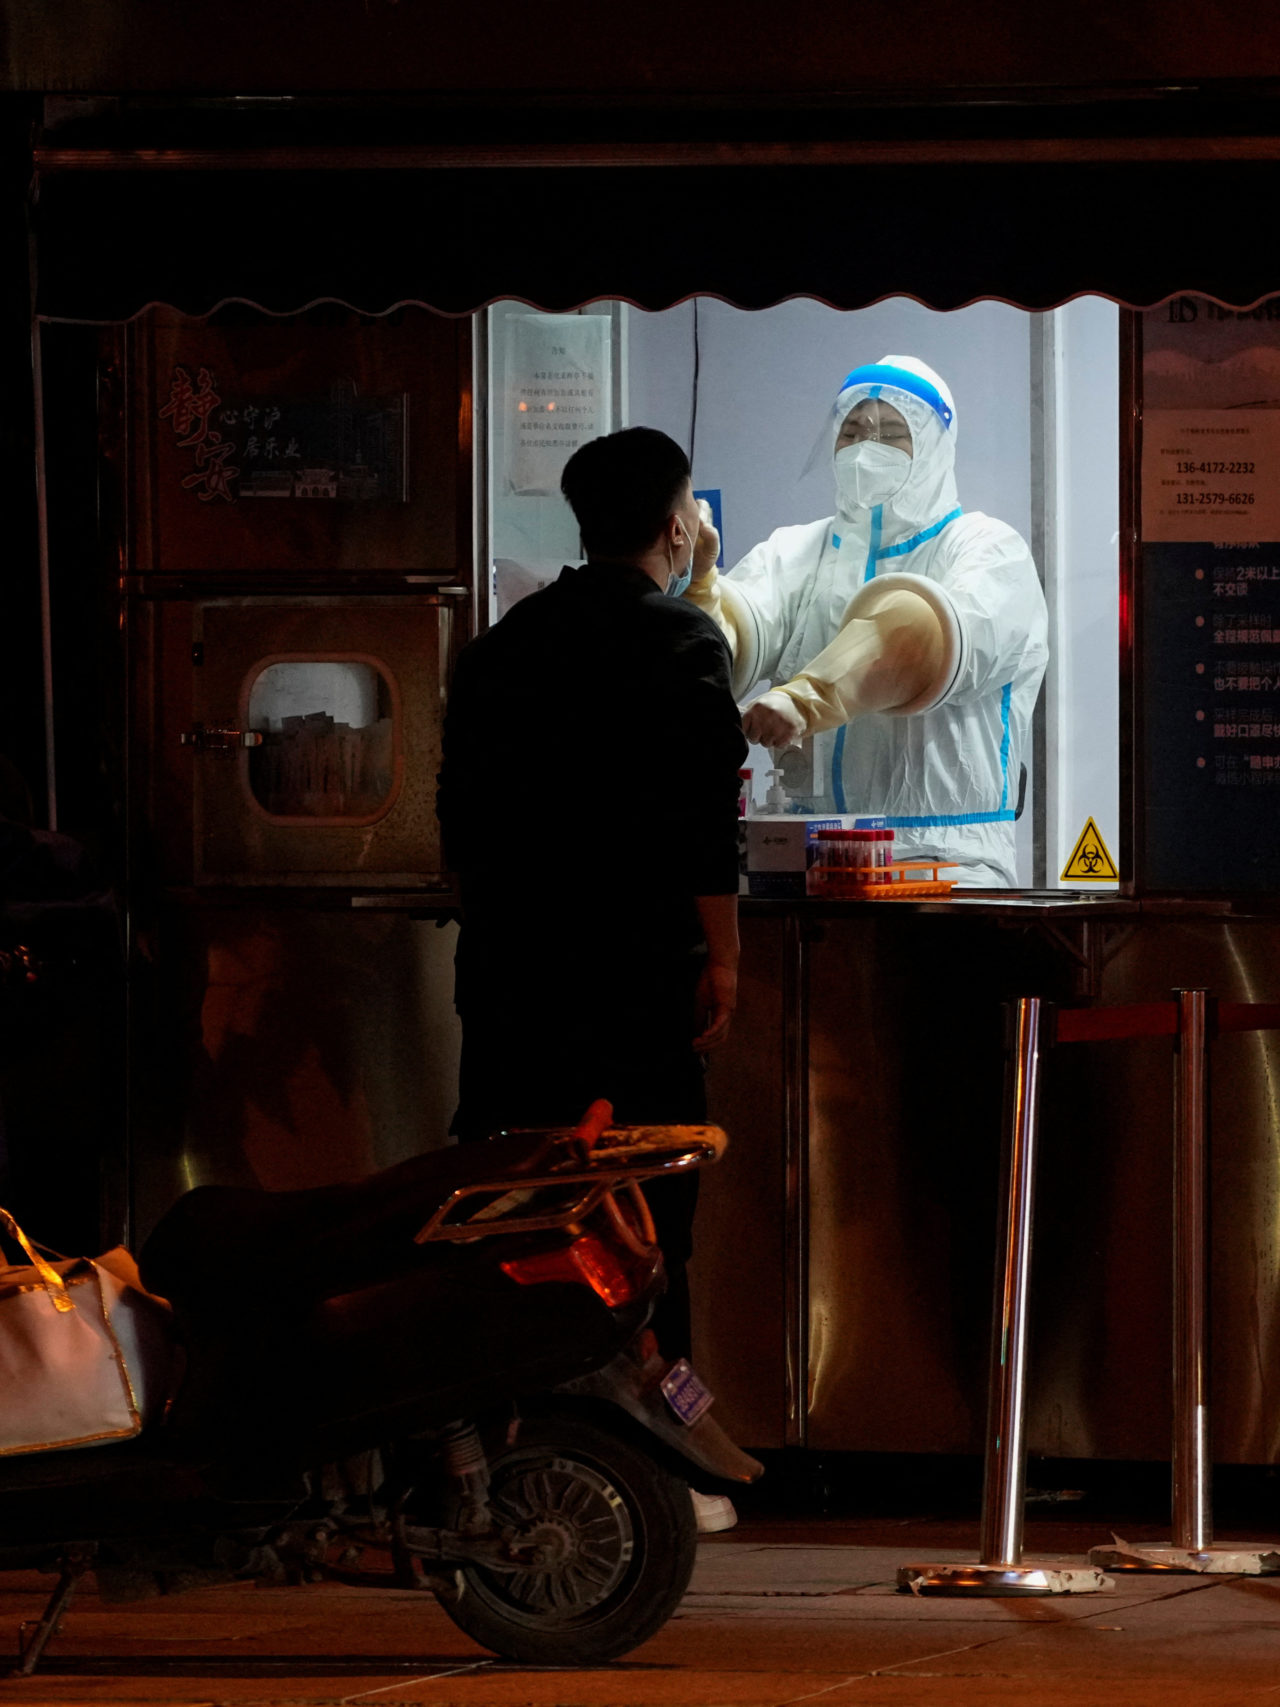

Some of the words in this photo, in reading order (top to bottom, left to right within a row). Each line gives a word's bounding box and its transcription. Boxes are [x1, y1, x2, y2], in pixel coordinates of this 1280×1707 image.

[1176, 462, 1256, 474] 136-4172-2232
[1176, 493, 1255, 505] 131-2579-6626
[1213, 583, 1248, 597] 不交谈
